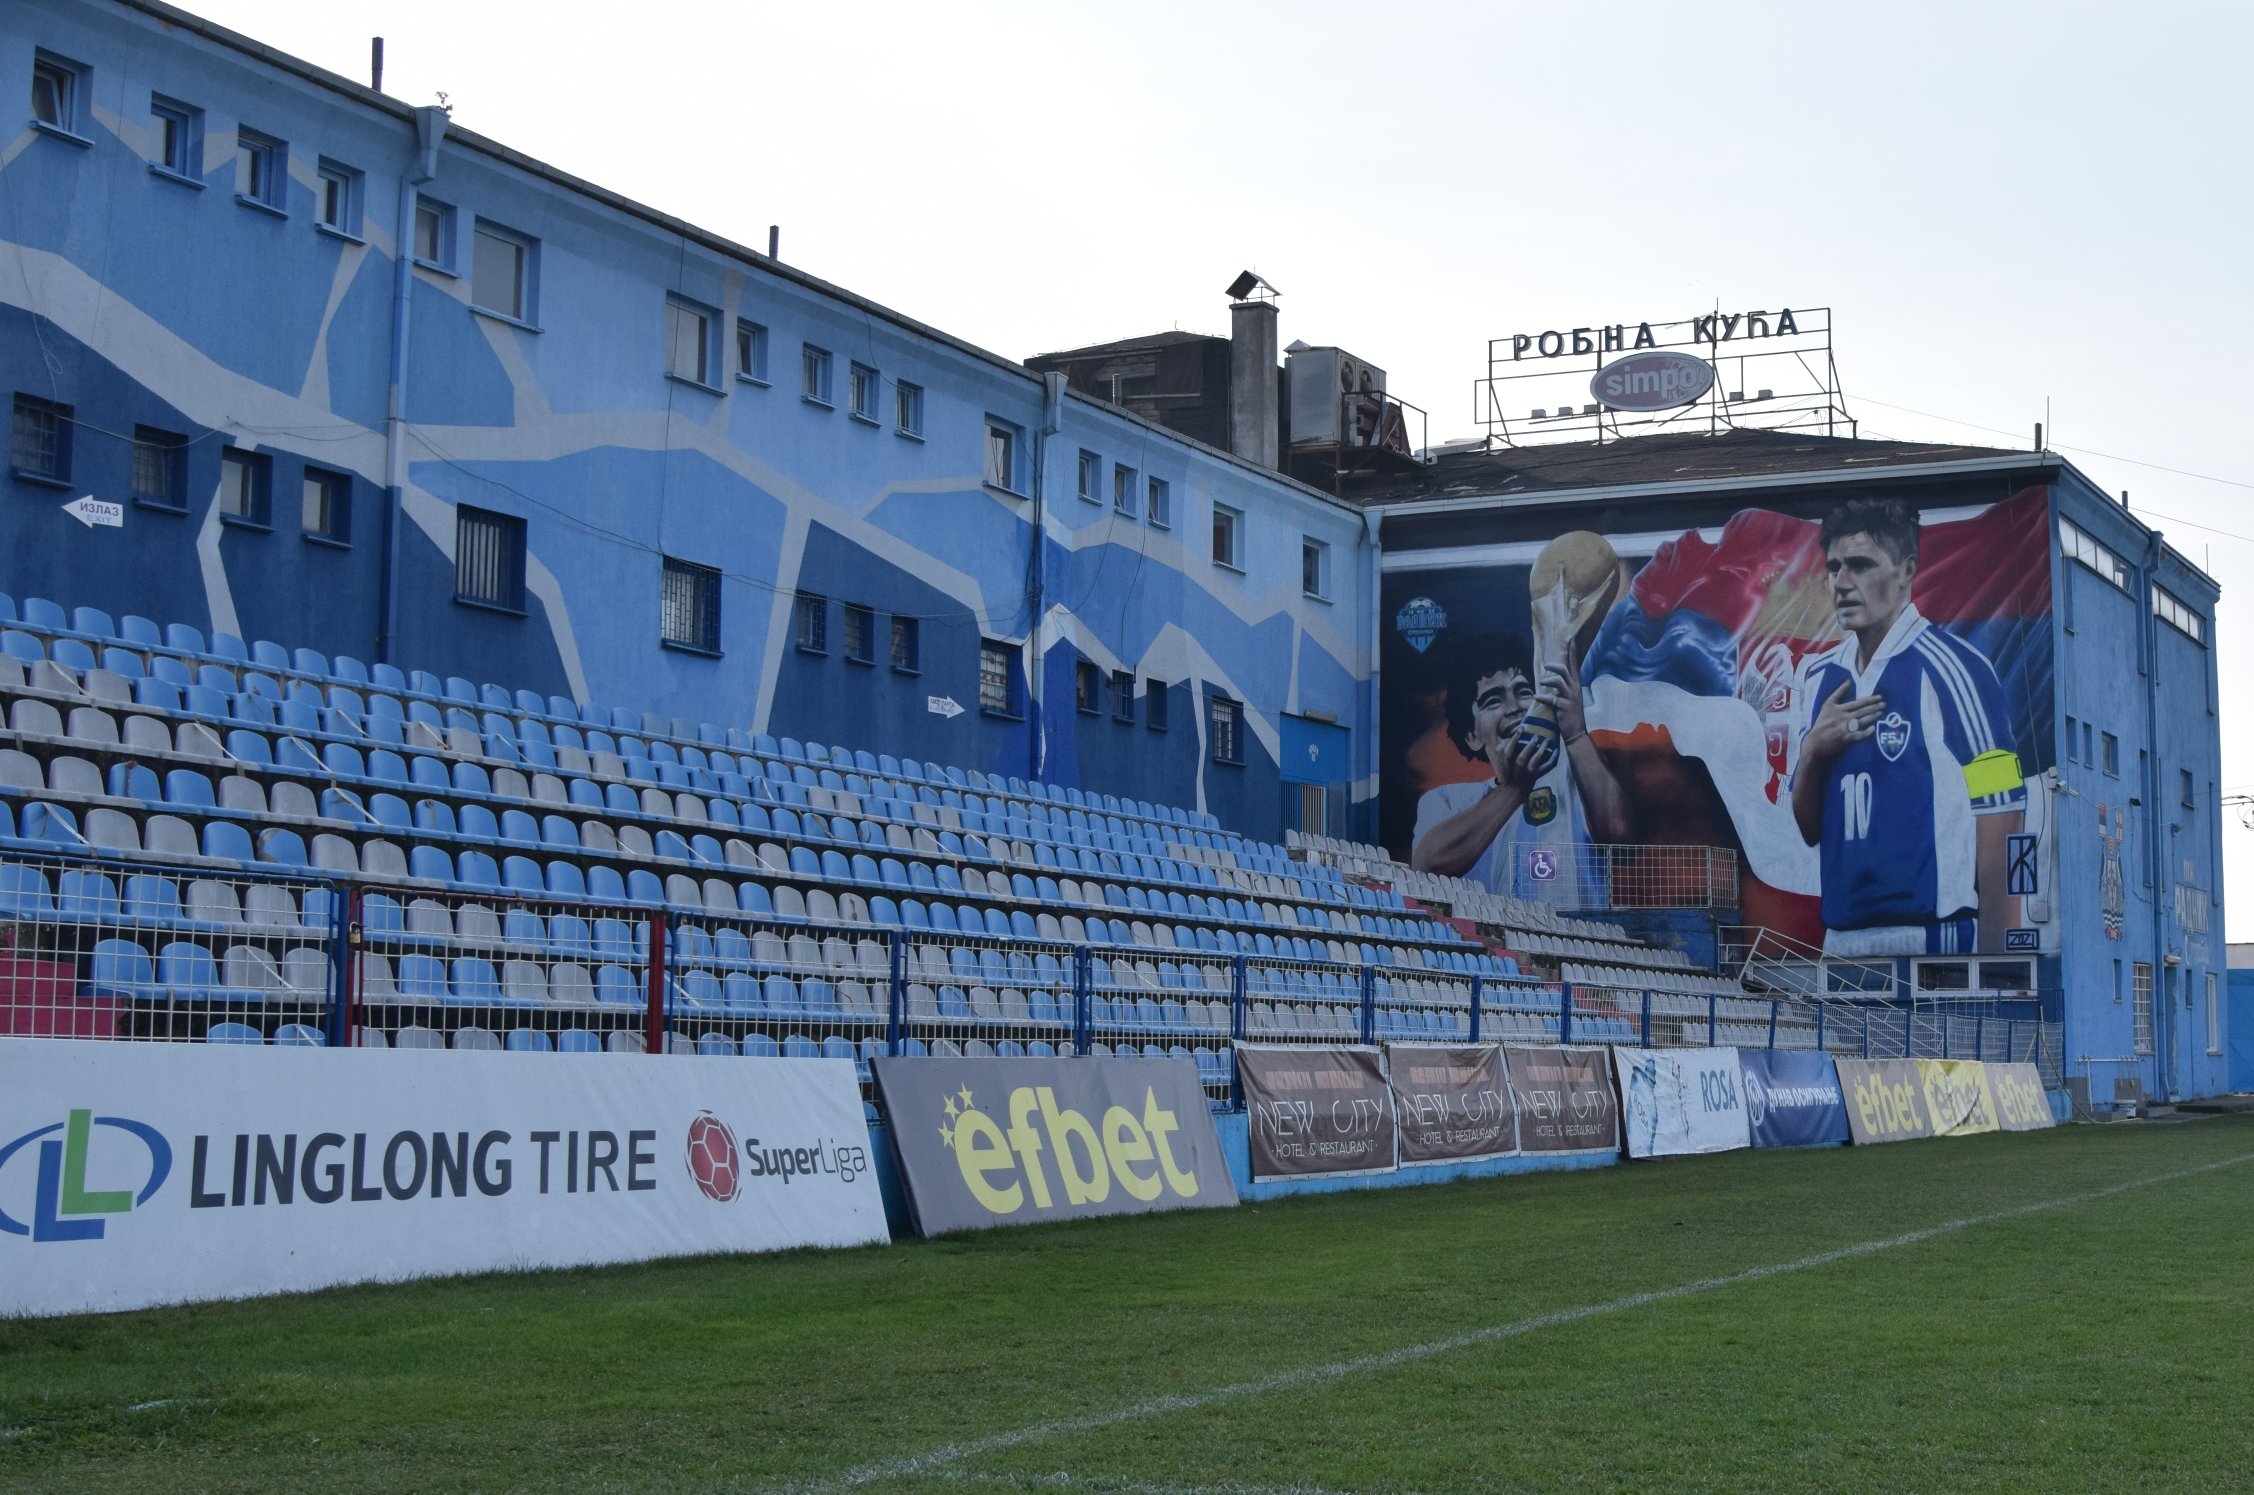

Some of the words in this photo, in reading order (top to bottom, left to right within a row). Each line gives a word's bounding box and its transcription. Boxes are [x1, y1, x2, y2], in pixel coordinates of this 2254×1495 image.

[1513, 322, 1656, 361] РОБНА
[1693, 308, 1799, 344] КУЋА
[1606, 364, 1698, 399] simpo
[80, 502, 119, 516] ИЗЛАЗ
[86, 514, 112, 524] EXIT
[1841, 773, 1873, 840] 10
[1403, 1094, 1449, 1126] NEW
[1461, 1090, 1503, 1122] CITY
[1520, 1091, 1560, 1119] NEW
[1572, 1091, 1607, 1118] CITY
[1700, 1067, 1739, 1112] ROSA
[1856, 1074, 1923, 1136] efbet
[1996, 1074, 2047, 1124] efbet
[1257, 1101, 1314, 1136] NEW
[1332, 1099, 1383, 1134] CITY
[1420, 1131, 1443, 1145] HOTEL
[1456, 1127, 1500, 1142] RESTAURANT
[1537, 1126, 1555, 1136] HOTEL
[1566, 1124, 1602, 1136] RESTAURANT
[746, 1138, 867, 1184] SuperLiga
[954, 1085, 1199, 1213] efbet
[1276, 1143, 1304, 1157] HOTEL
[1320, 1139, 1374, 1155] RESTAURANT
[190, 1130, 511, 1208] LINGLONG
[530, 1130, 657, 1194] TIRE
